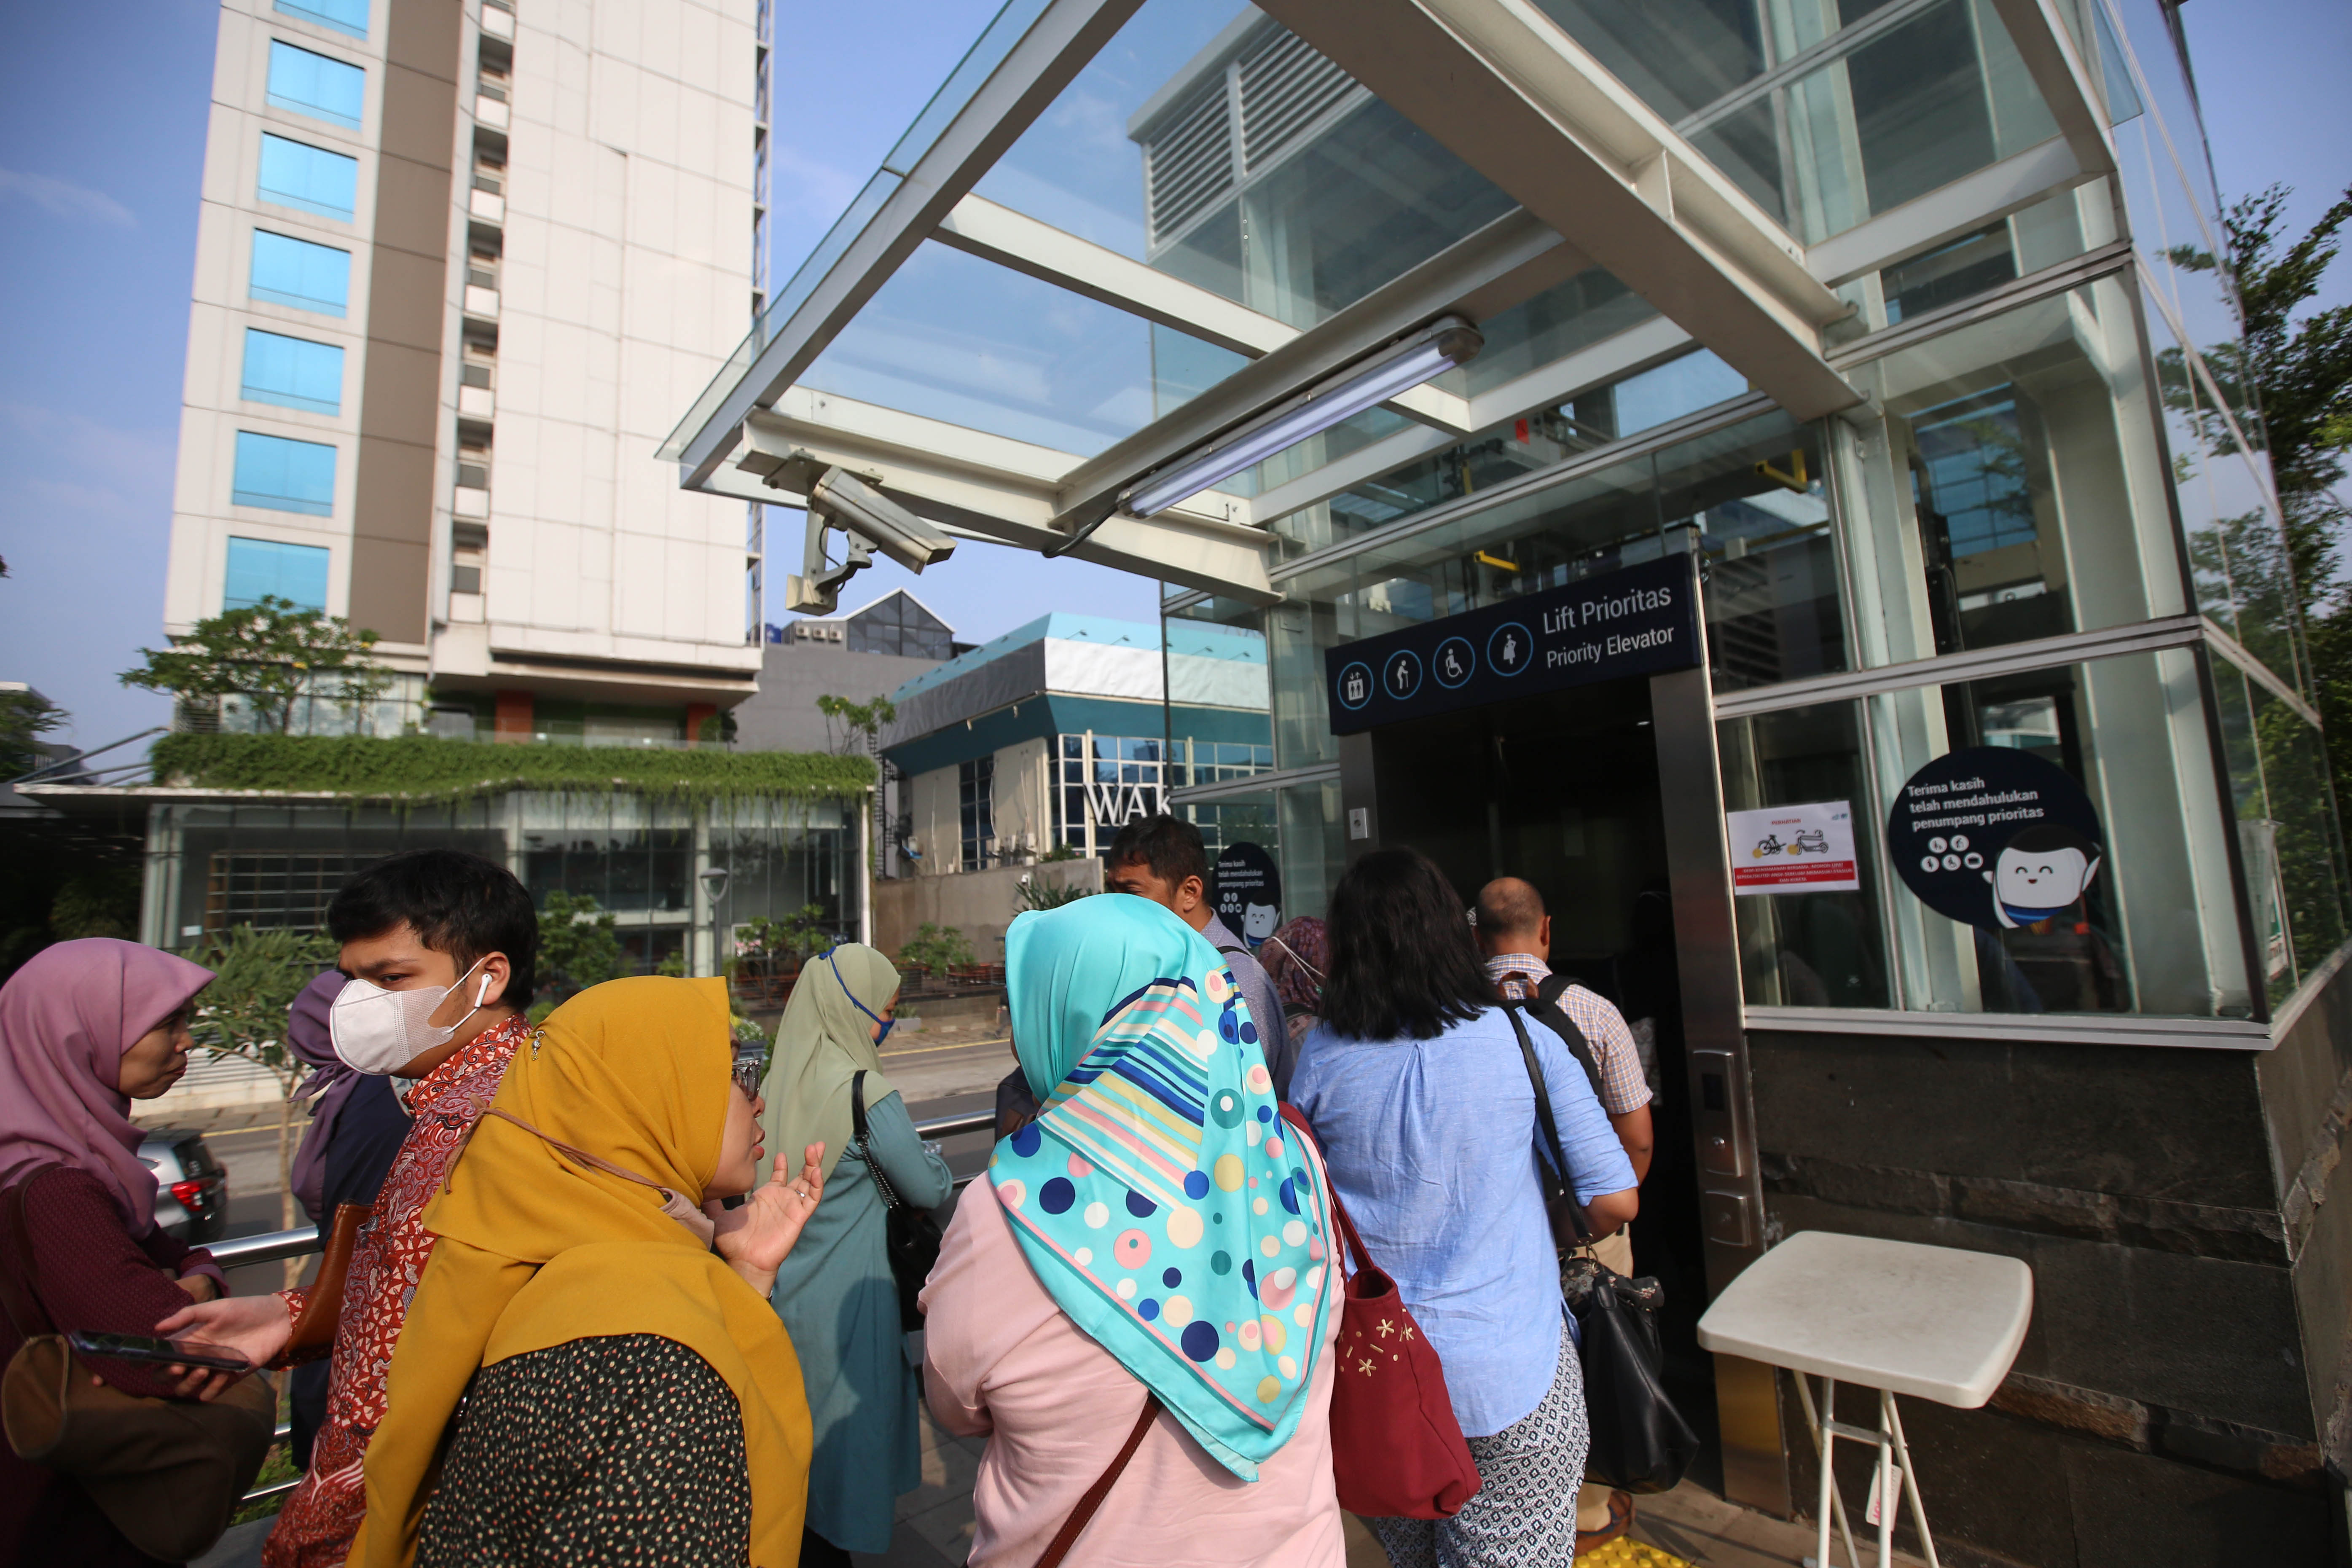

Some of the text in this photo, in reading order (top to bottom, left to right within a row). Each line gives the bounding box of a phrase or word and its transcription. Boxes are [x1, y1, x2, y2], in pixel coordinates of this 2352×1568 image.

[1544, 587, 1672, 634] Lift Prioritas
[1547, 627, 1674, 669] Priority Elevator
[1907, 776, 1985, 797] Terima kasih
[1909, 789, 2038, 813] telah mendahulukan
[1912, 807, 2044, 833] penumpang prioritas
